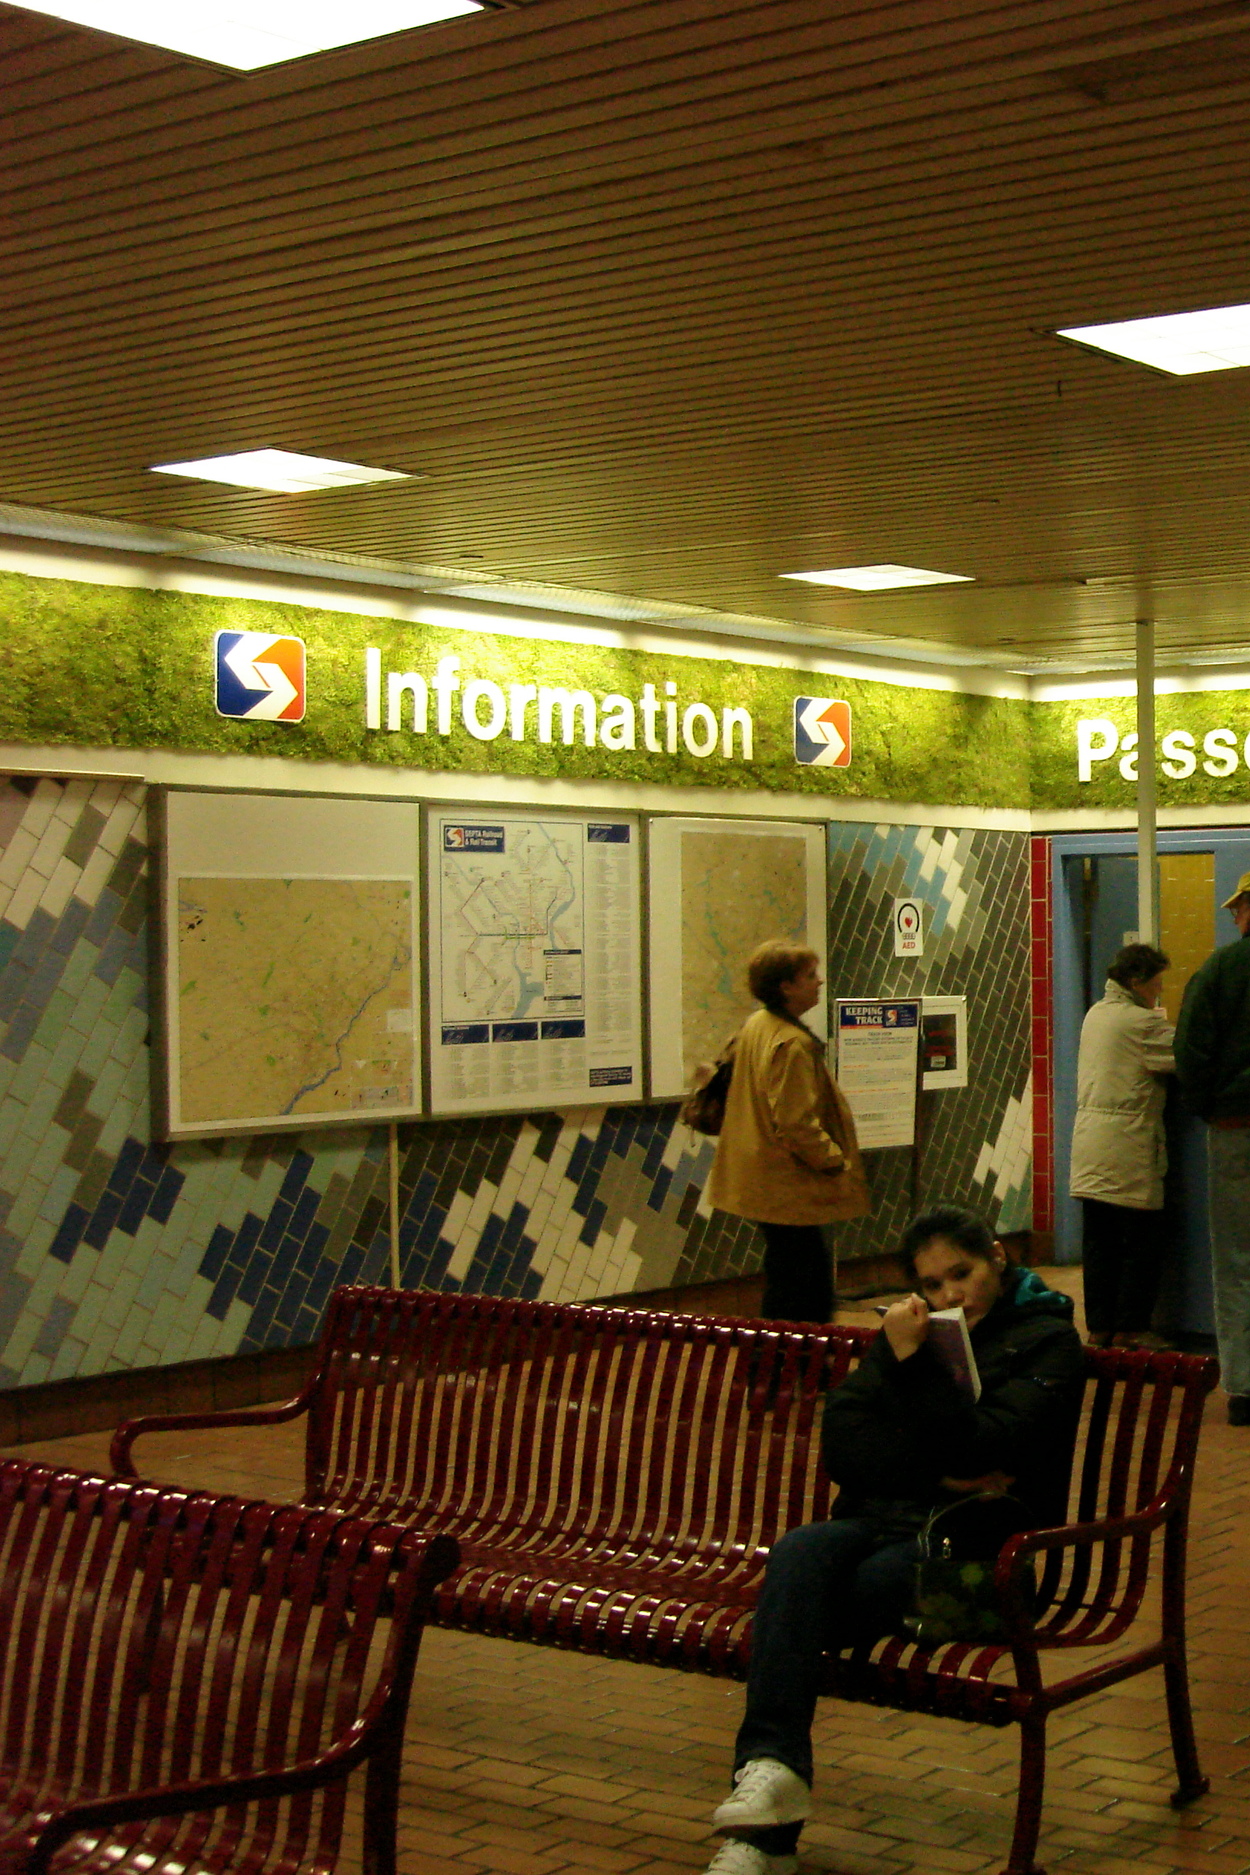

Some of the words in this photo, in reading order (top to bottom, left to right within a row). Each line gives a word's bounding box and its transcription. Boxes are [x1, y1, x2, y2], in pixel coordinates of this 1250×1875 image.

[366, 647, 753, 761] Information
[902, 941, 916, 949] AED
[845, 1006, 883, 1016] KEEPING
[855, 1015, 883, 1025] TRACK
